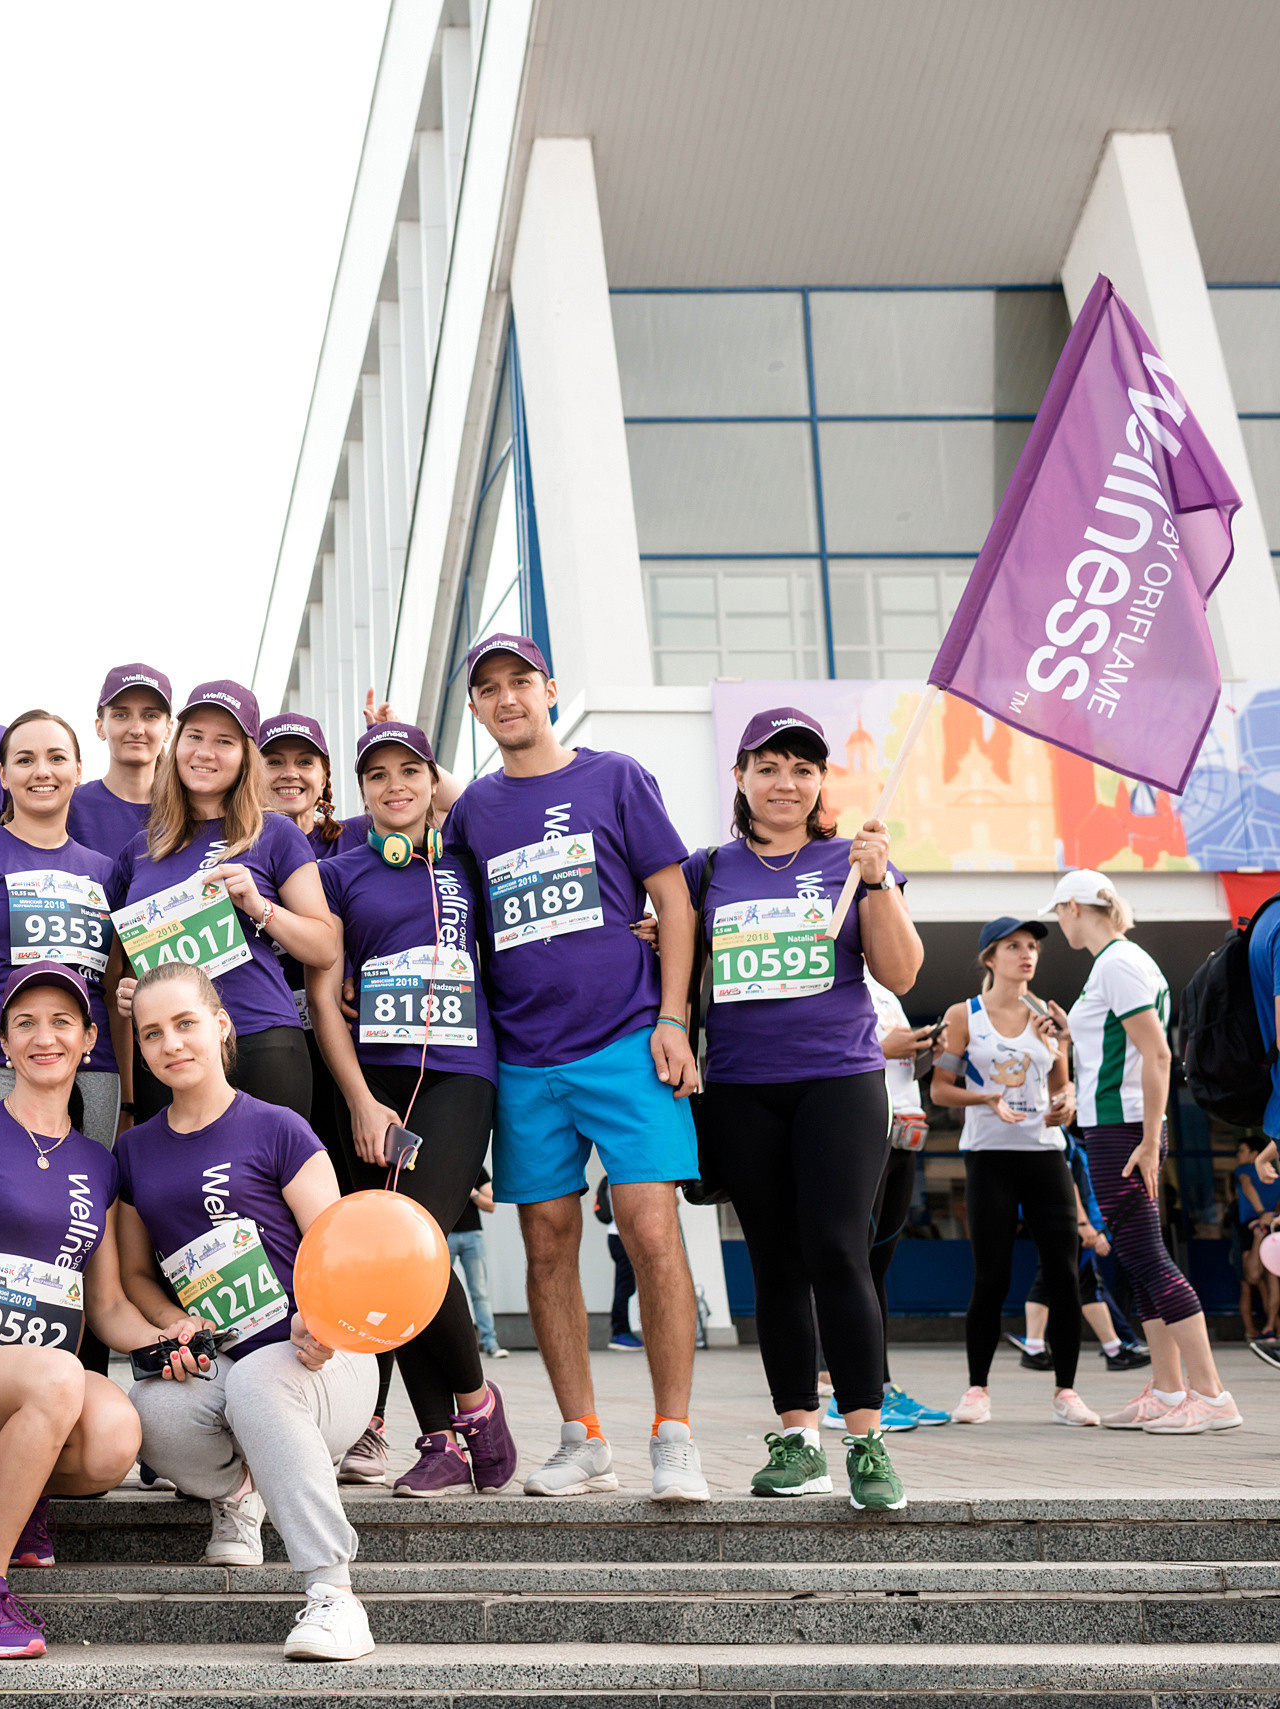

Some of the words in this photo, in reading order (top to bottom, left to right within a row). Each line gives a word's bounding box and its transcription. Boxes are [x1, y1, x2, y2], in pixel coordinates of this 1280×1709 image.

[1156, 518, 1181, 562] BY
[1087, 562, 1173, 719] ORIFLAME
[517, 874, 538, 888] 2018
[552, 870, 579, 881] ANDREI
[43, 900, 66, 909] 2018
[433, 869, 469, 951] Wellne
[503, 880, 584, 926] 8189
[24, 914, 103, 948] 9353
[156, 923, 179, 938] 2018
[746, 933, 769, 942] 2018
[787, 934, 814, 943] Natalia
[133, 913, 235, 973] 14017
[458, 927, 467, 952] ORIF
[717, 945, 830, 981] 10595
[395, 977, 419, 987] 2018
[431, 983, 460, 993] Nadzeya
[374, 993, 463, 1024] 8188
[55, 1174, 99, 1269] Wellne
[197, 1274, 217, 1290] 2018
[8, 1294, 33, 1307] 2018
[367, 1336, 405, 1345] люб
